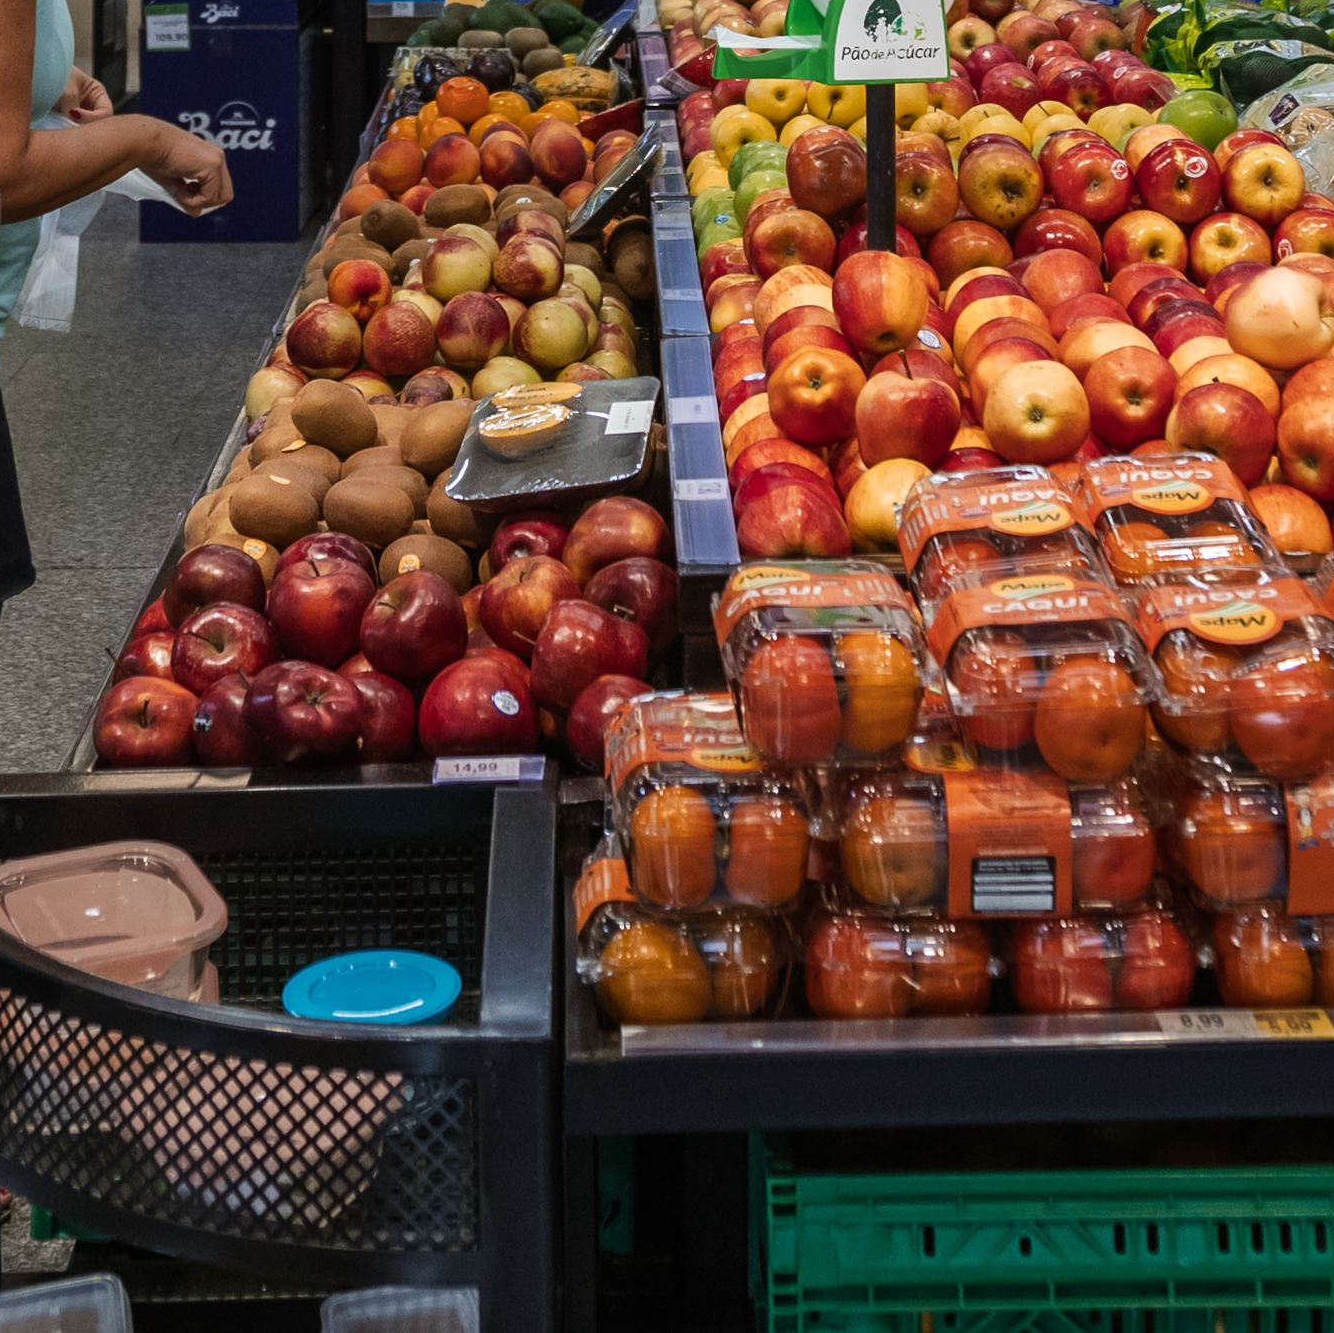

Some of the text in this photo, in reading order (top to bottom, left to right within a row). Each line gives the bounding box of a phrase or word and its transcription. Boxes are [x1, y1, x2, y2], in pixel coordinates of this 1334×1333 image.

[200, 4, 240, 23] Baci
[841, 47, 870, 60] Pão
[871, 50, 884, 60] de
[178, 111, 276, 150] Baci
[1119, 469, 1213, 483] CAQUI
[1140, 489, 1201, 503] Mape
[999, 579, 1068, 593] Mape
[1173, 588, 1278, 607] CAQUI
[982, 596, 1090, 614] CAQUI
[1199, 614, 1267, 629] Mape
[454, 763, 498, 775] 14,99
